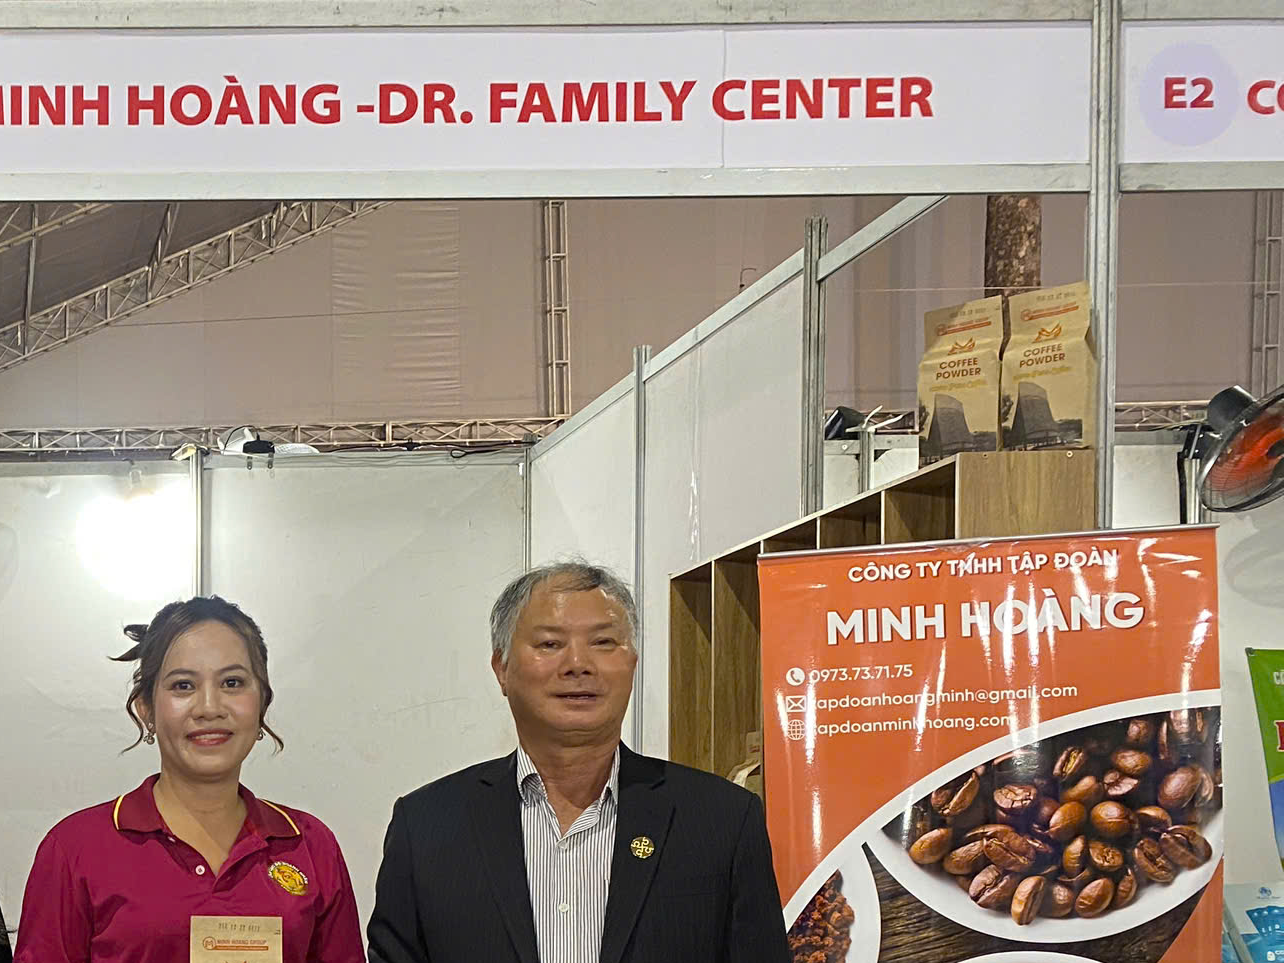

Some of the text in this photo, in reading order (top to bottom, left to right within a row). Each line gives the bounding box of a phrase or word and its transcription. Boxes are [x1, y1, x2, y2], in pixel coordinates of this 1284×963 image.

[126, 74, 341, 126] HOÀNG
[487, 79, 699, 124] FAMILY
[711, 76, 935, 122] CENTER
[1163, 76, 1215, 109] E2
[1019, 352, 1066, 368] POWDER
[1023, 343, 1063, 358] COFFEE
[935, 367, 981, 381] POWDER
[939, 357, 979, 370] COFFEE
[848, 547, 1118, 583] CÔNG TY TNHH TẬP ĐOÀN
[827, 588, 1145, 646] MINH HOÀNG
[810, 664, 914, 684] 0973.73.71.75
[815, 686, 1078, 711] apdoanhoangminh@gmail.com
